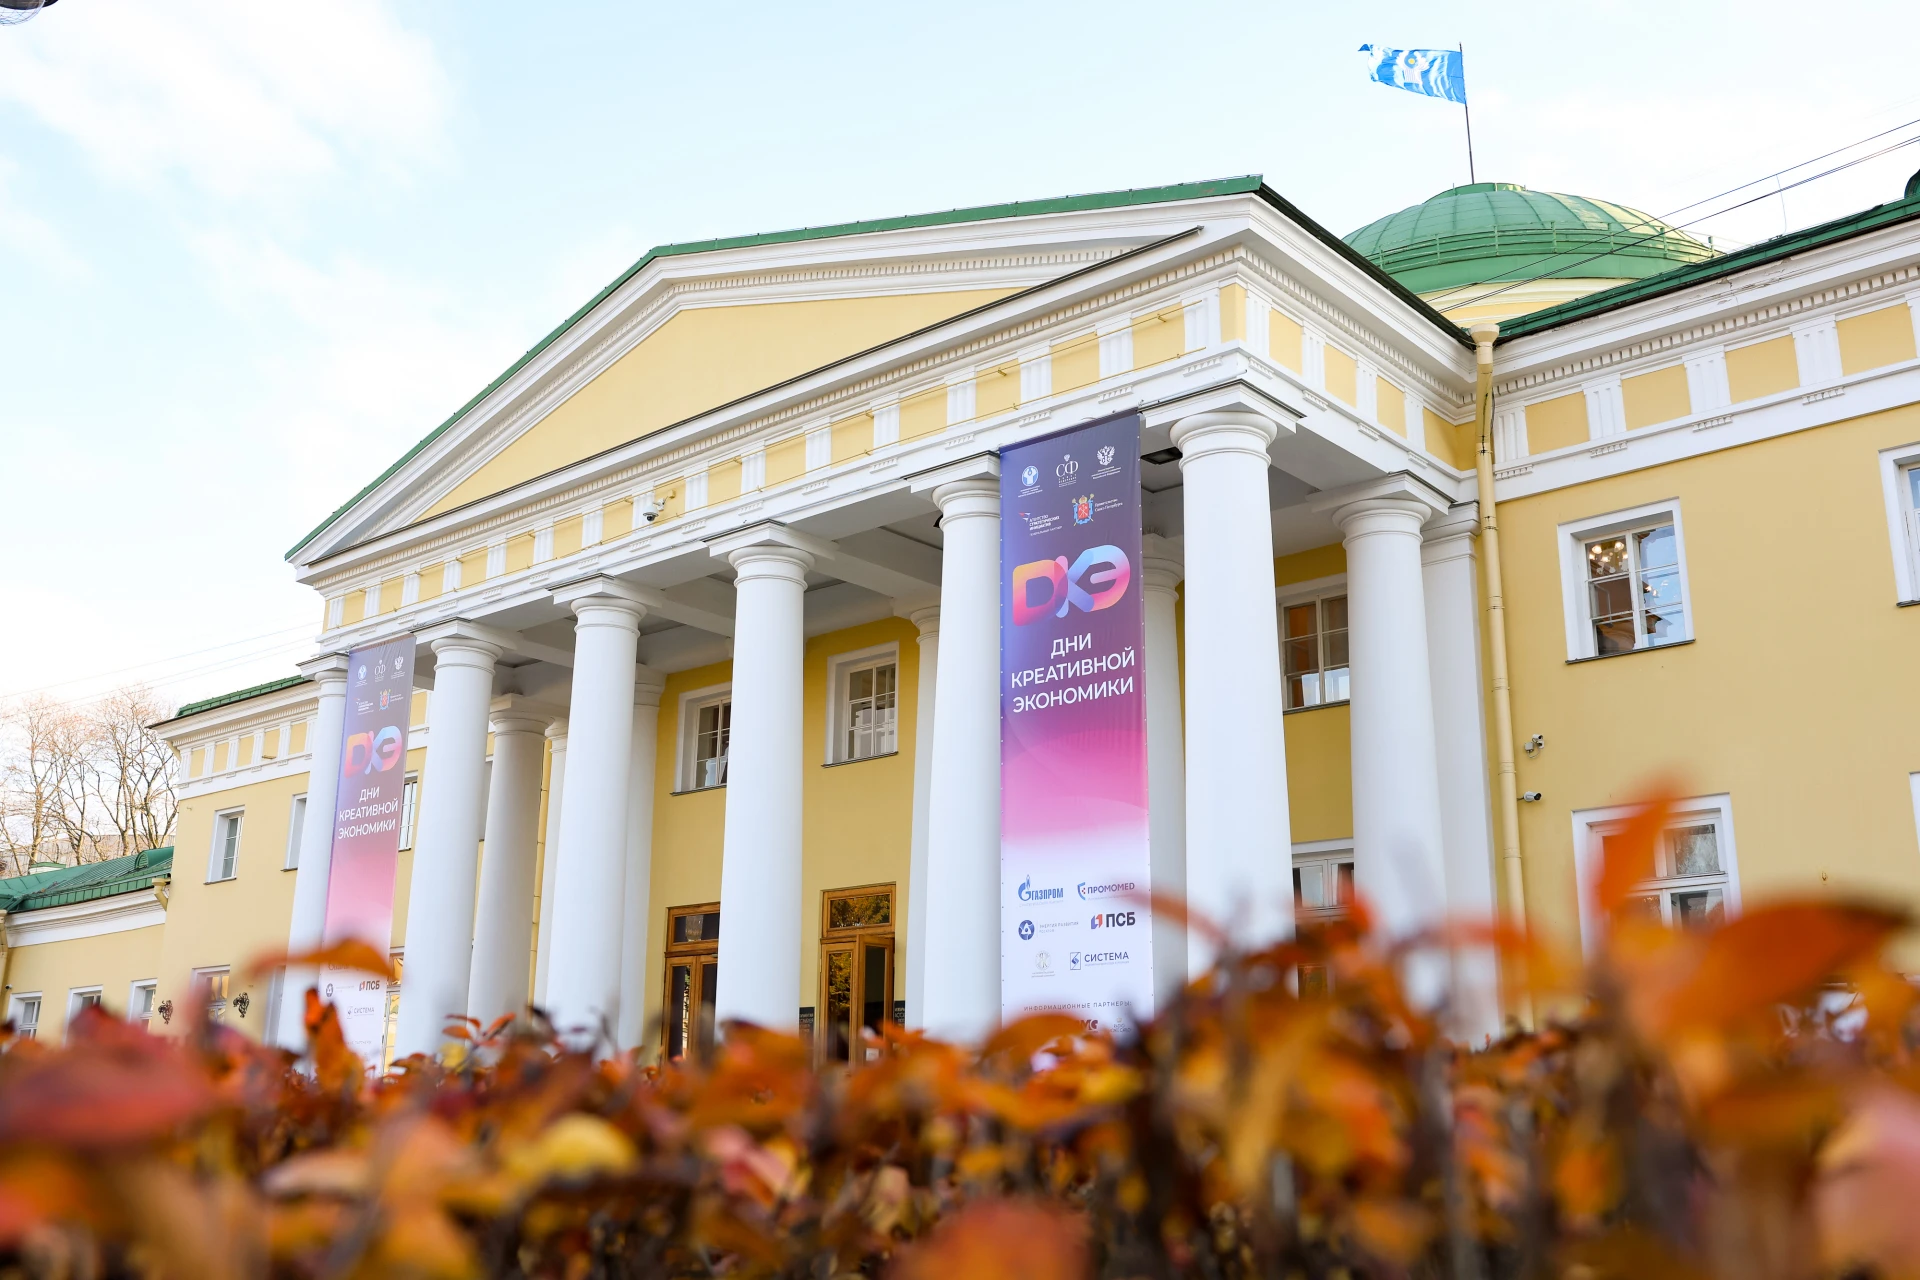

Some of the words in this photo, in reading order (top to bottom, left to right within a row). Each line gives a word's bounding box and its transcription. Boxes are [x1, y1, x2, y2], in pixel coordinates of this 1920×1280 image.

[1051, 632, 1092, 660] ДНИ
[1011, 646, 1135, 689] КРЕАТИВНОЙ
[1012, 676, 1134, 713] ЭКОНОМИКИ
[358, 786, 380, 804] ДНИ
[338, 797, 399, 822] КРЕАТИВНОЙ
[337, 818, 396, 840] ЭКОНОМИКИ
[1031, 887, 1064, 901] ГАЗПРОМ
[1105, 911, 1136, 928] ПСБ
[1084, 951, 1130, 963] СИСТЕМА
[365, 980, 380, 991] ПСБ
[353, 1006, 375, 1014] СИСТЕМА
[1023, 1002, 1091, 1012] ИНФОРМАЦИОННЫЕ
[1093, 1000, 1132, 1008] ПАРТНЕРЫ:
